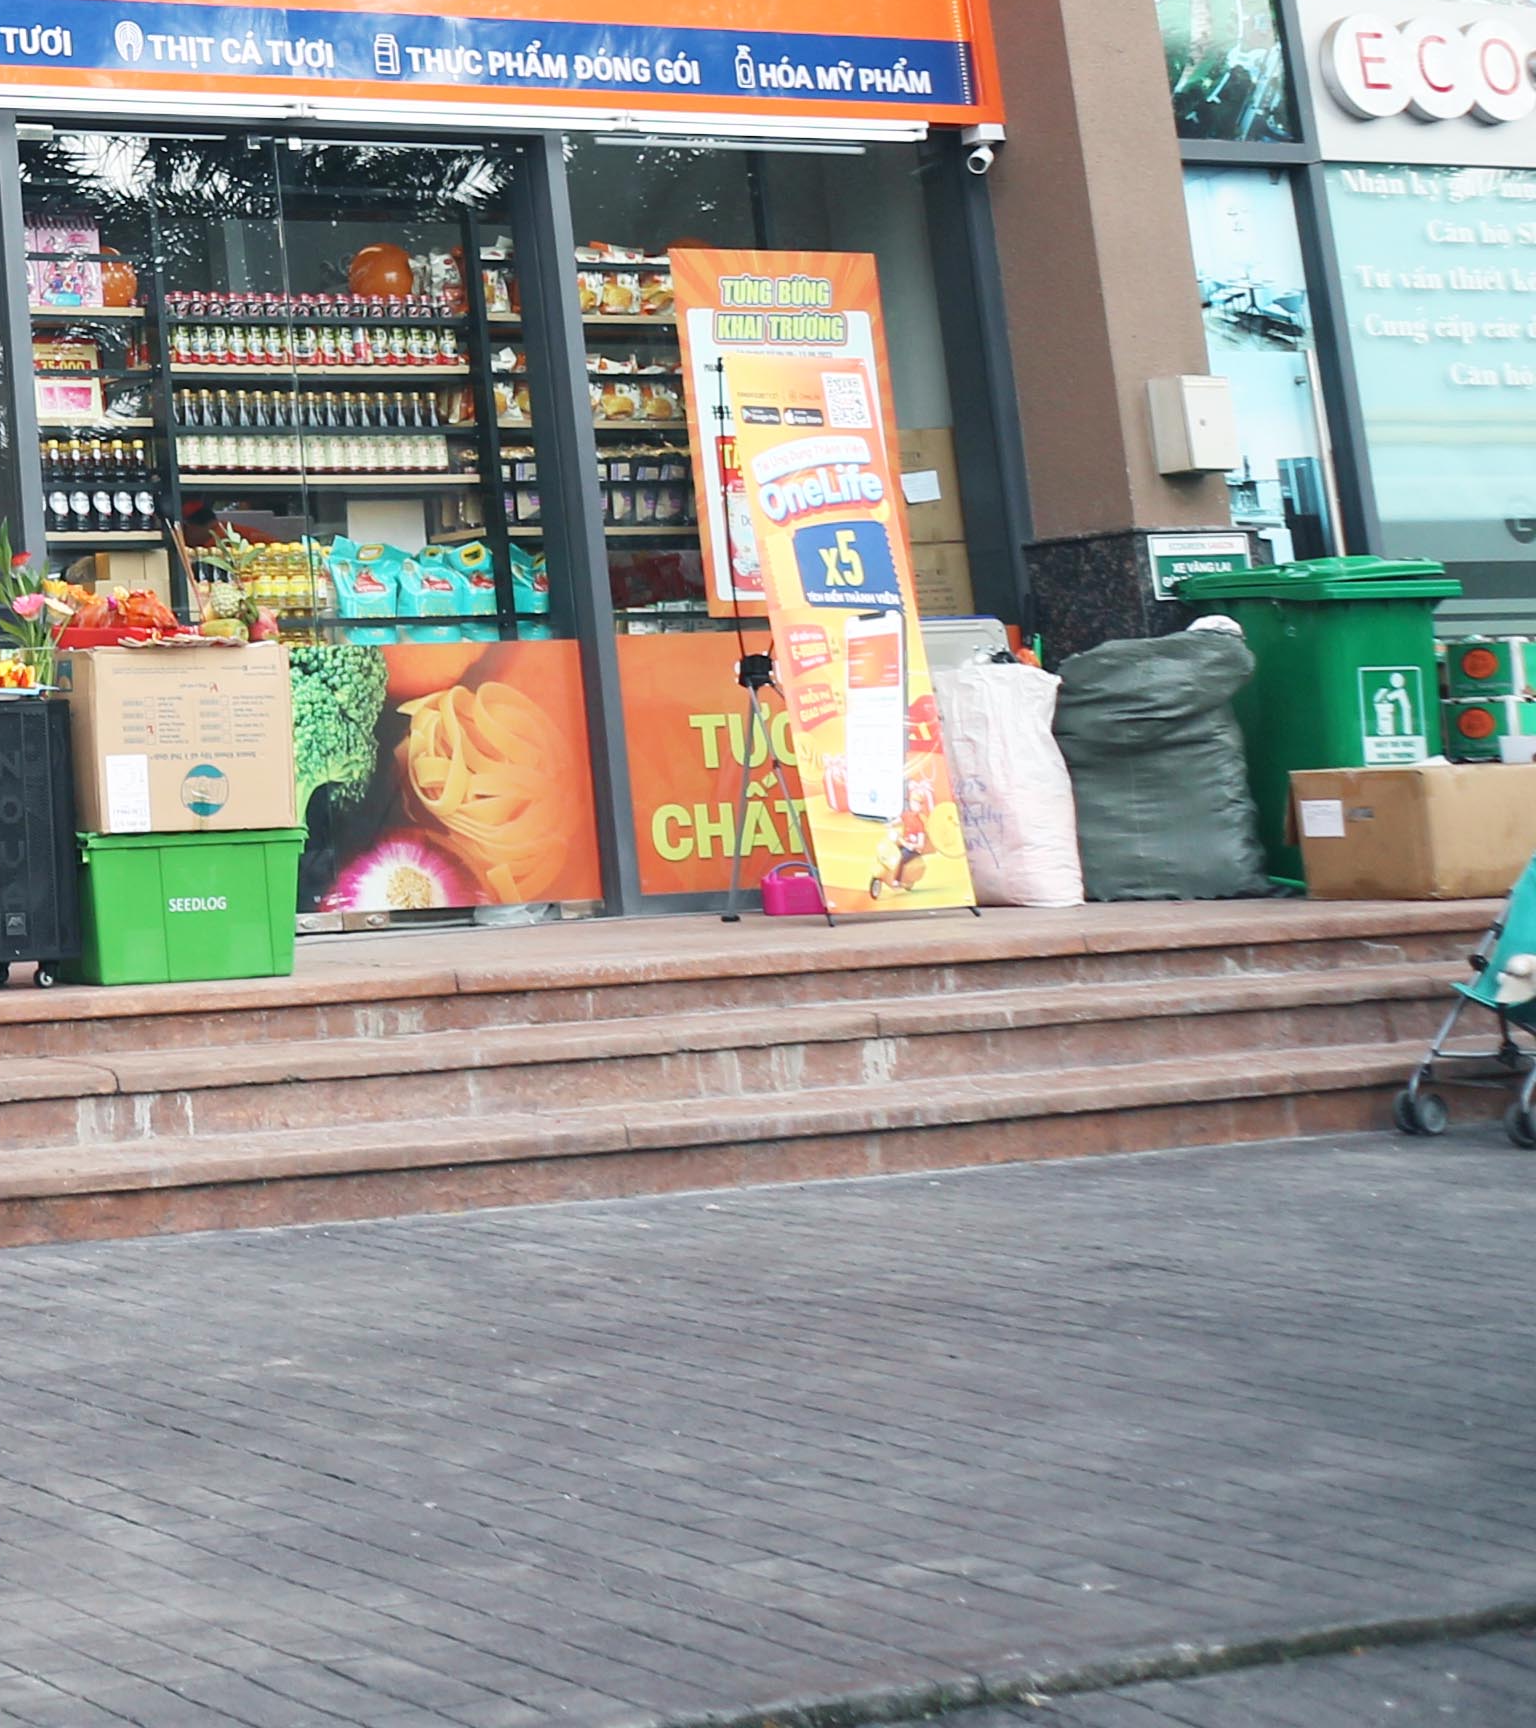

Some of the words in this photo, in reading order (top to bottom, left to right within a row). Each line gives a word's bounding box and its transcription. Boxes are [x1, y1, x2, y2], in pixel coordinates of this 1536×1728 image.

[0, 23, 73, 58] TƯƠI
[148, 33, 217, 73] THỊT
[222, 35, 262, 67] CÁ
[267, 39, 334, 69] TƯƠI
[407, 44, 484, 81] THỰC
[489, 40, 568, 81] PHẨM
[574, 49, 649, 85] ĐÓNG
[655, 52, 700, 86] GÓI
[759, 57, 812, 91] HÓA
[817, 56, 858, 93] MỸ
[860, 54, 931, 96] PHẨM
[721, 276, 772, 305] TƯNG
[777, 276, 830, 306] BỪNG
[717, 313, 764, 341] KHAI
[769, 311, 844, 342] TRƯƠNG
[759, 462, 885, 522] OneLife
[818, 529, 865, 587] x5
[168, 895, 227, 913] SEEDLOG
